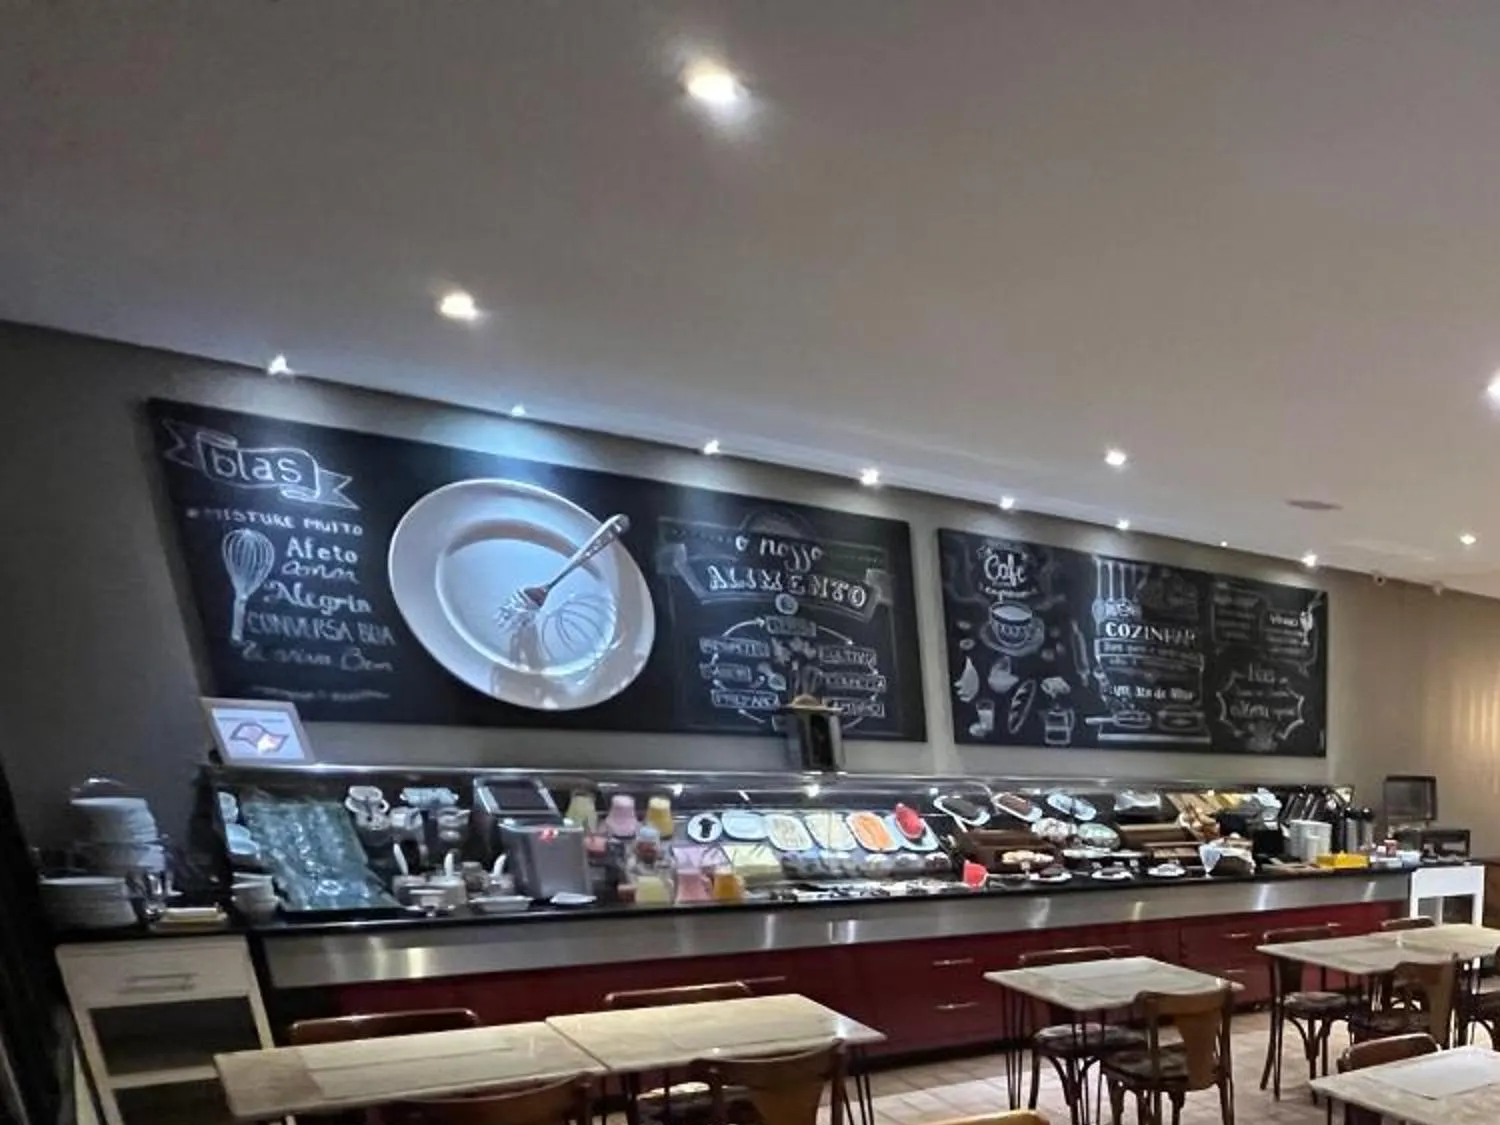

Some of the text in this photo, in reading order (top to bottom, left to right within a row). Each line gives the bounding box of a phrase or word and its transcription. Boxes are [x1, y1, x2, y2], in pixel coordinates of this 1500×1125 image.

[211, 446, 302, 485] blas
[303, 518, 364, 536] MUITO
[286, 536, 359, 564] Afeto
[707, 564, 867, 609] ALIMENTO
